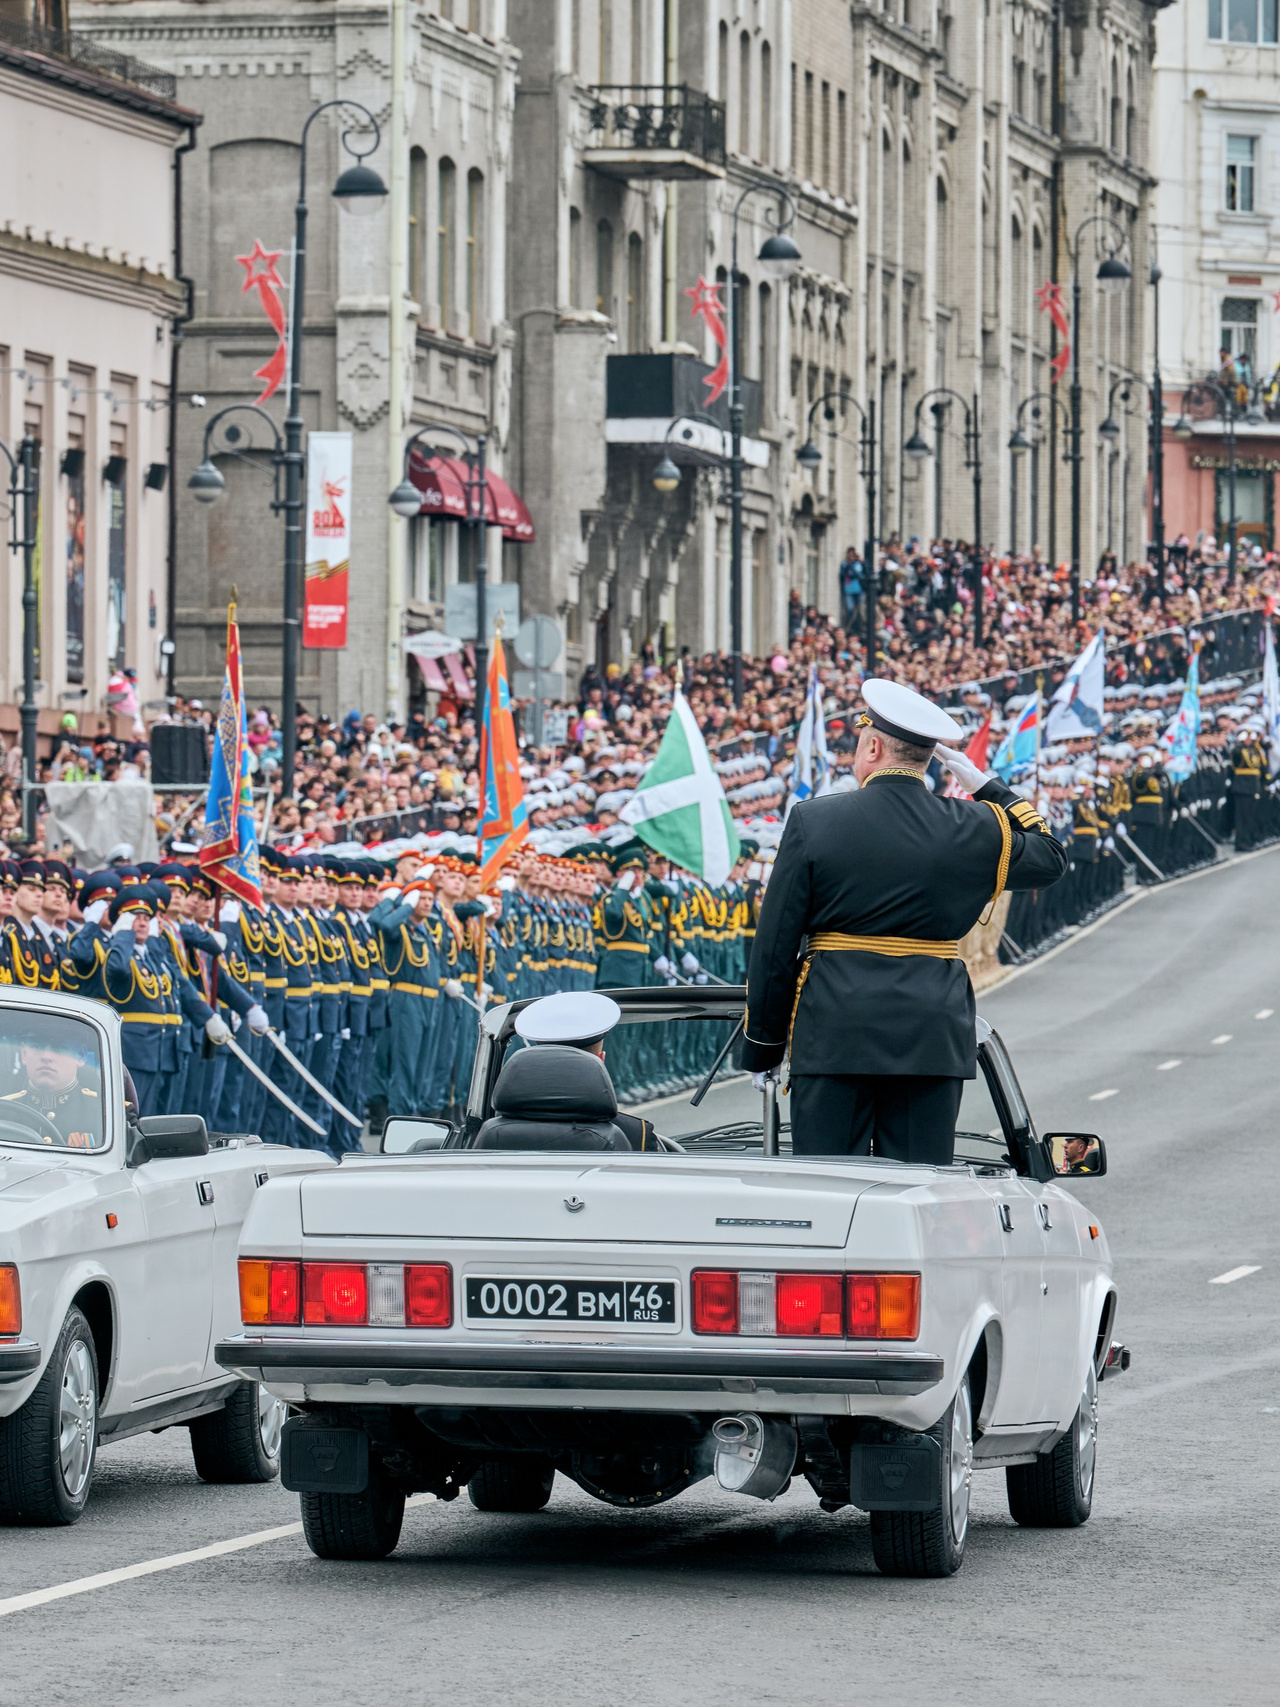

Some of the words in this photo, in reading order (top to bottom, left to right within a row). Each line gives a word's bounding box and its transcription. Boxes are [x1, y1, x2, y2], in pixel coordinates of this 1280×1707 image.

[480, 1282, 568, 1316] 0002
[577, 1291, 621, 1318] ВМ
[629, 1284, 663, 1310] 46
[633, 1310, 660, 1321] RUS
